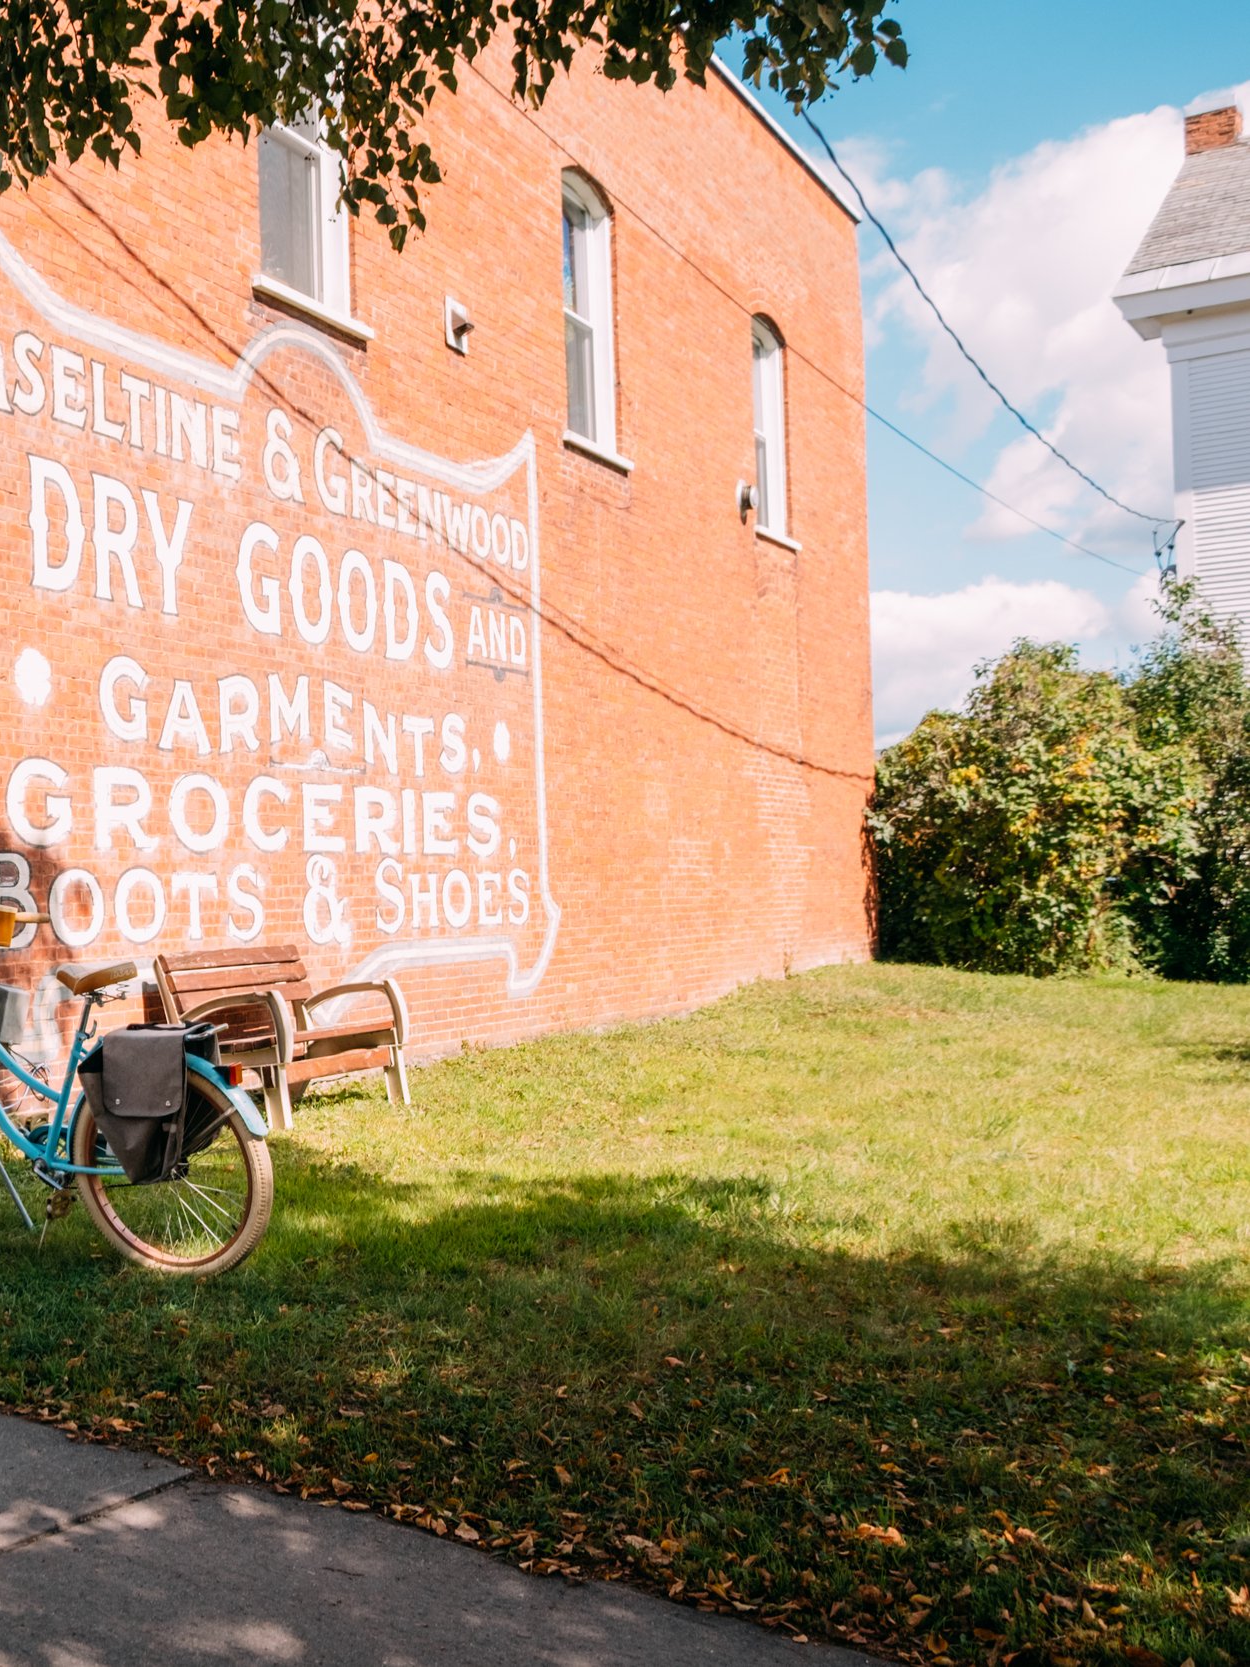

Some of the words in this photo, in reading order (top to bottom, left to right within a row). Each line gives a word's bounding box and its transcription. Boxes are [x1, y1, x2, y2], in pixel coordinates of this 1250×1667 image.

[27, 453, 194, 617] DRY
[235, 520, 454, 669] GOODS
[467, 605, 527, 665] AND
[262, 407, 306, 505] &
[313, 426, 530, 571] GREENWOOD
[302, 853, 351, 945] &
[375, 855, 530, 935] SHOES
